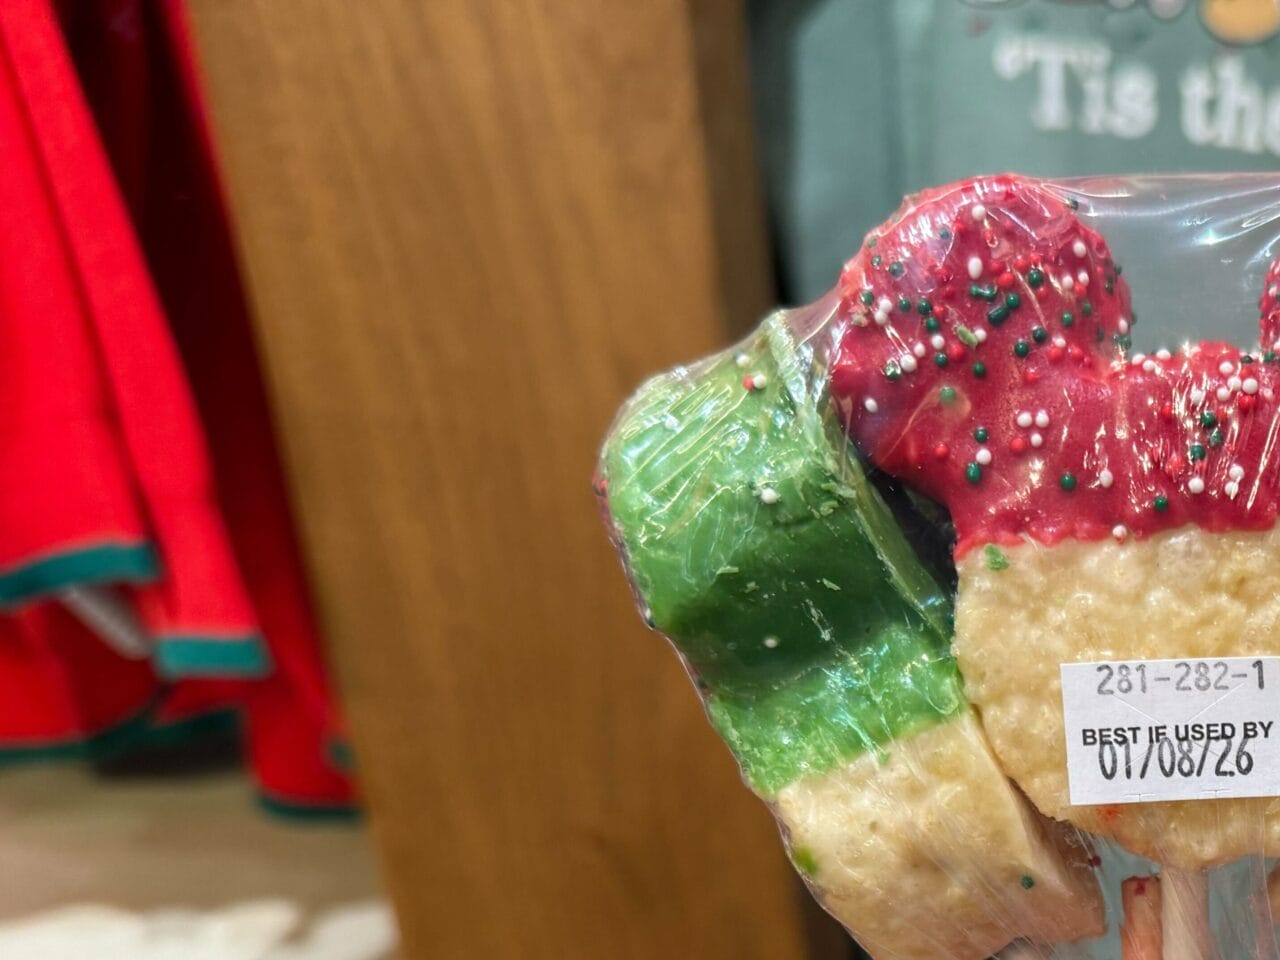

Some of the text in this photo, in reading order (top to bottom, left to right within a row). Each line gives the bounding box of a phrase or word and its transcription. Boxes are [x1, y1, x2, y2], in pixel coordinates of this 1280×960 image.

[1096, 660, 1265, 695] 281-282-1
[1082, 721, 1274, 746] BEST IF USED BY
[1099, 736, 1254, 780] 01/08/26
